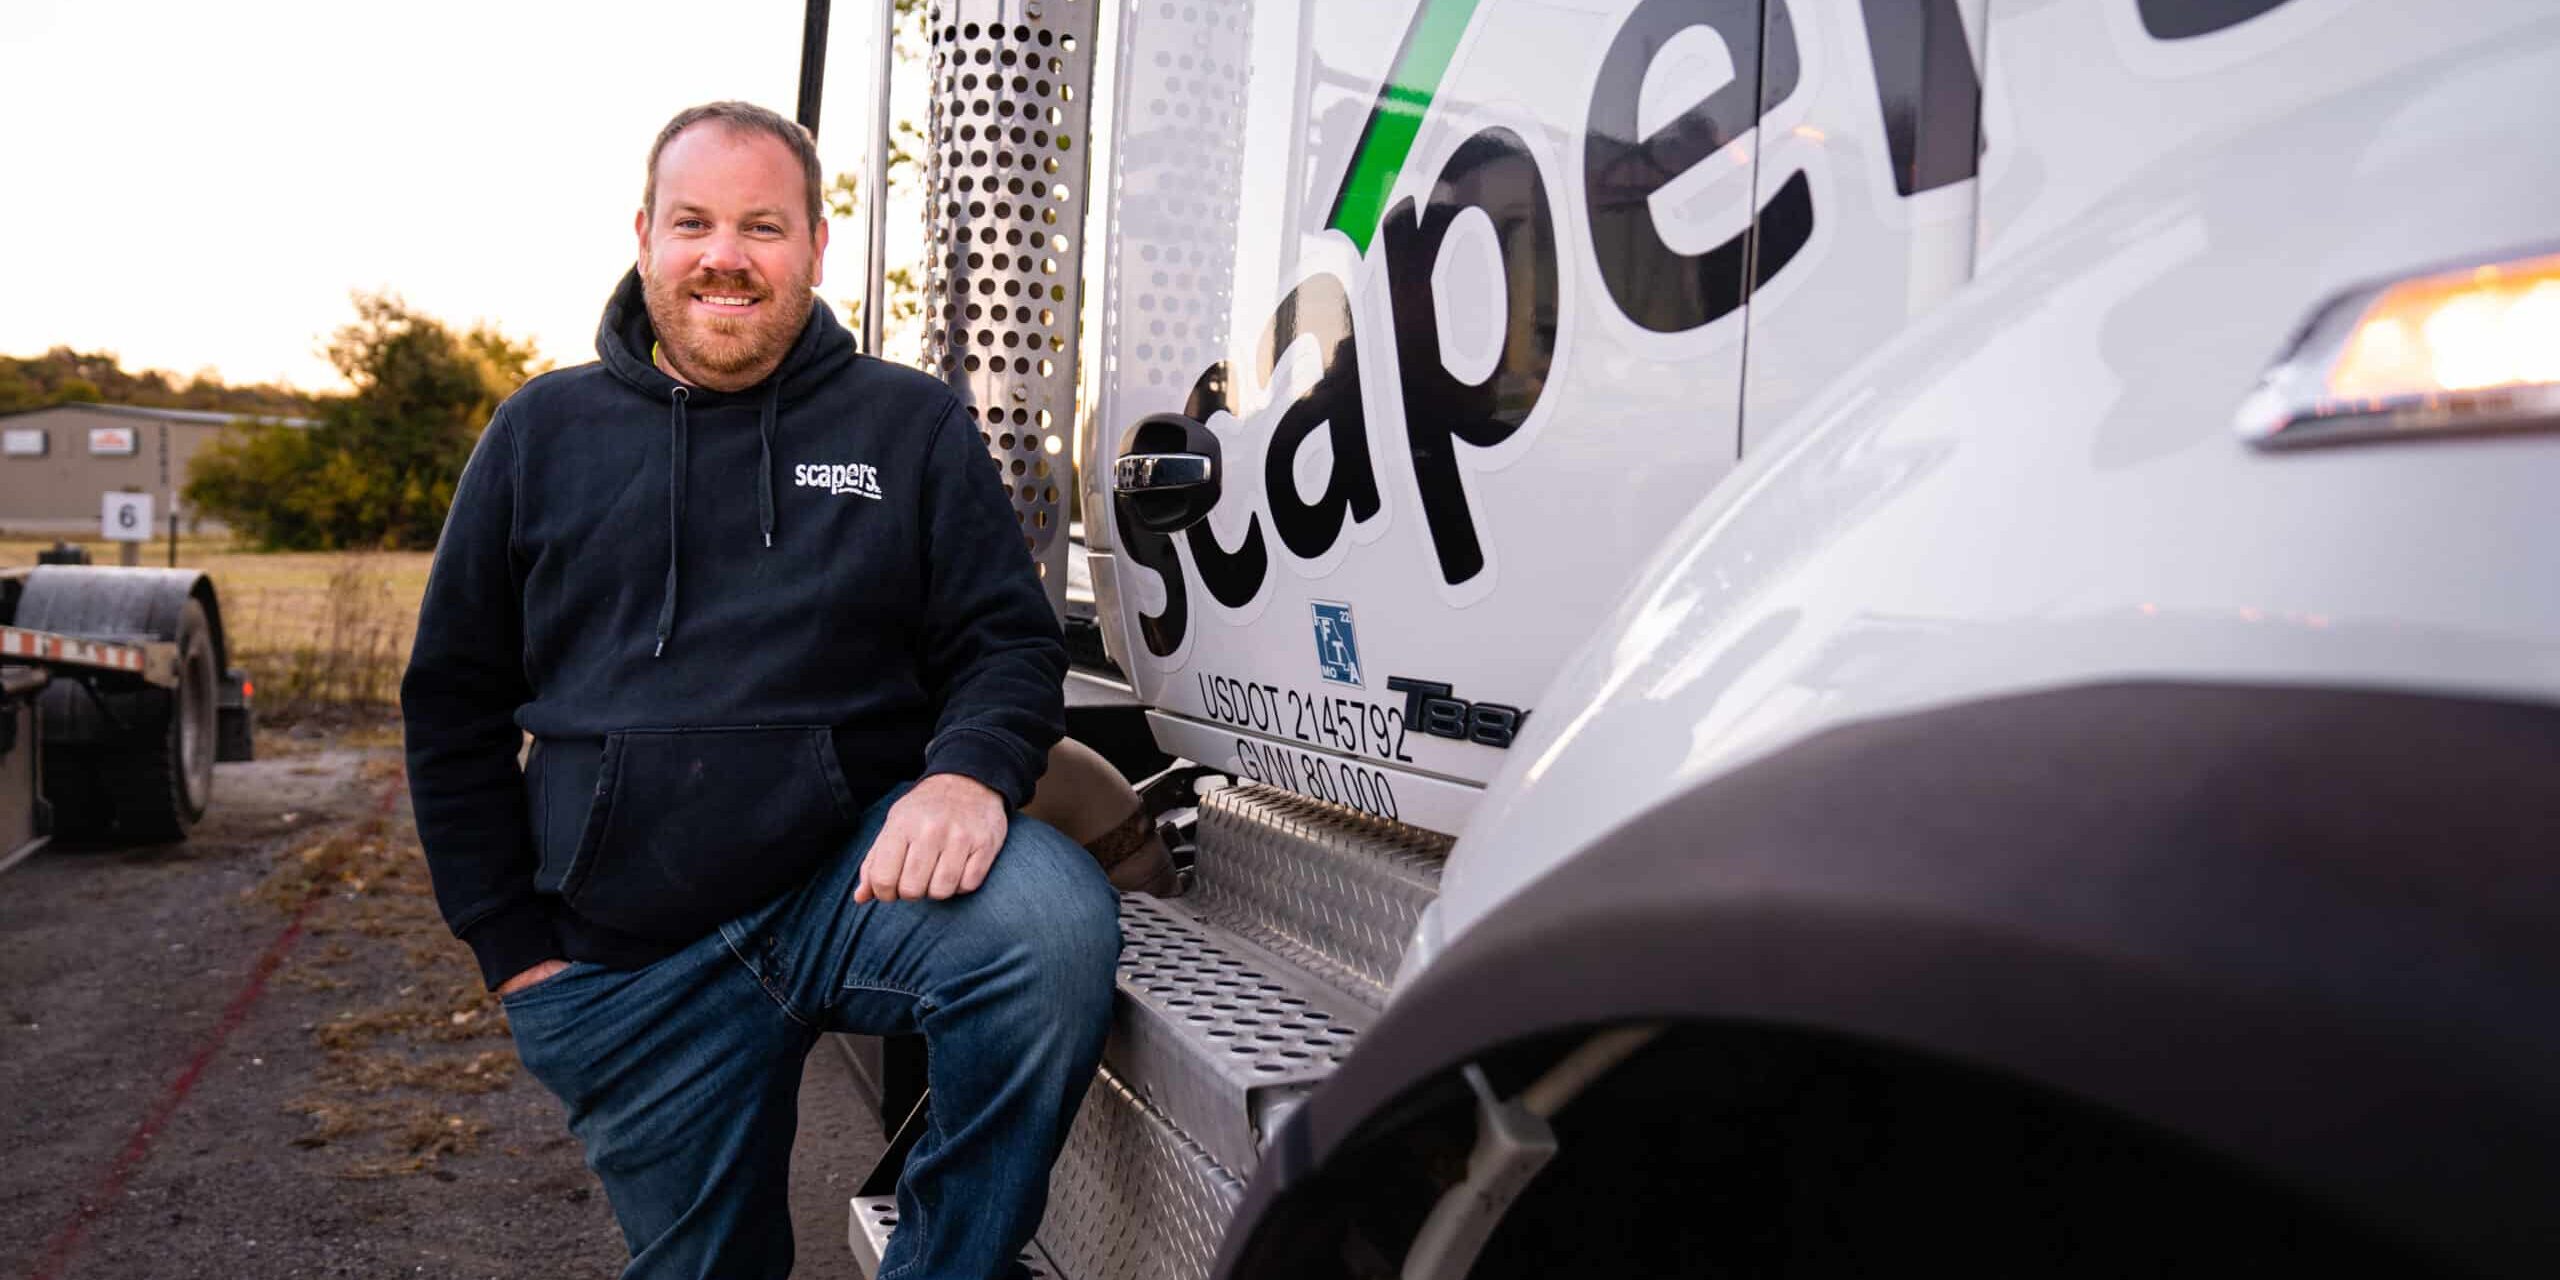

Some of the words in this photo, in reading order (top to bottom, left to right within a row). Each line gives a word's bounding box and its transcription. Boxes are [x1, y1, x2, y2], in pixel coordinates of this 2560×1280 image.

[118, 503, 137, 529] 6
[1339, 610, 1352, 624] 22
[1198, 672, 1283, 735] USDOT
[1288, 690, 1413, 763] 2145792
[1386, 675, 1533, 749] T88
[1237, 738, 1300, 794] GVW
